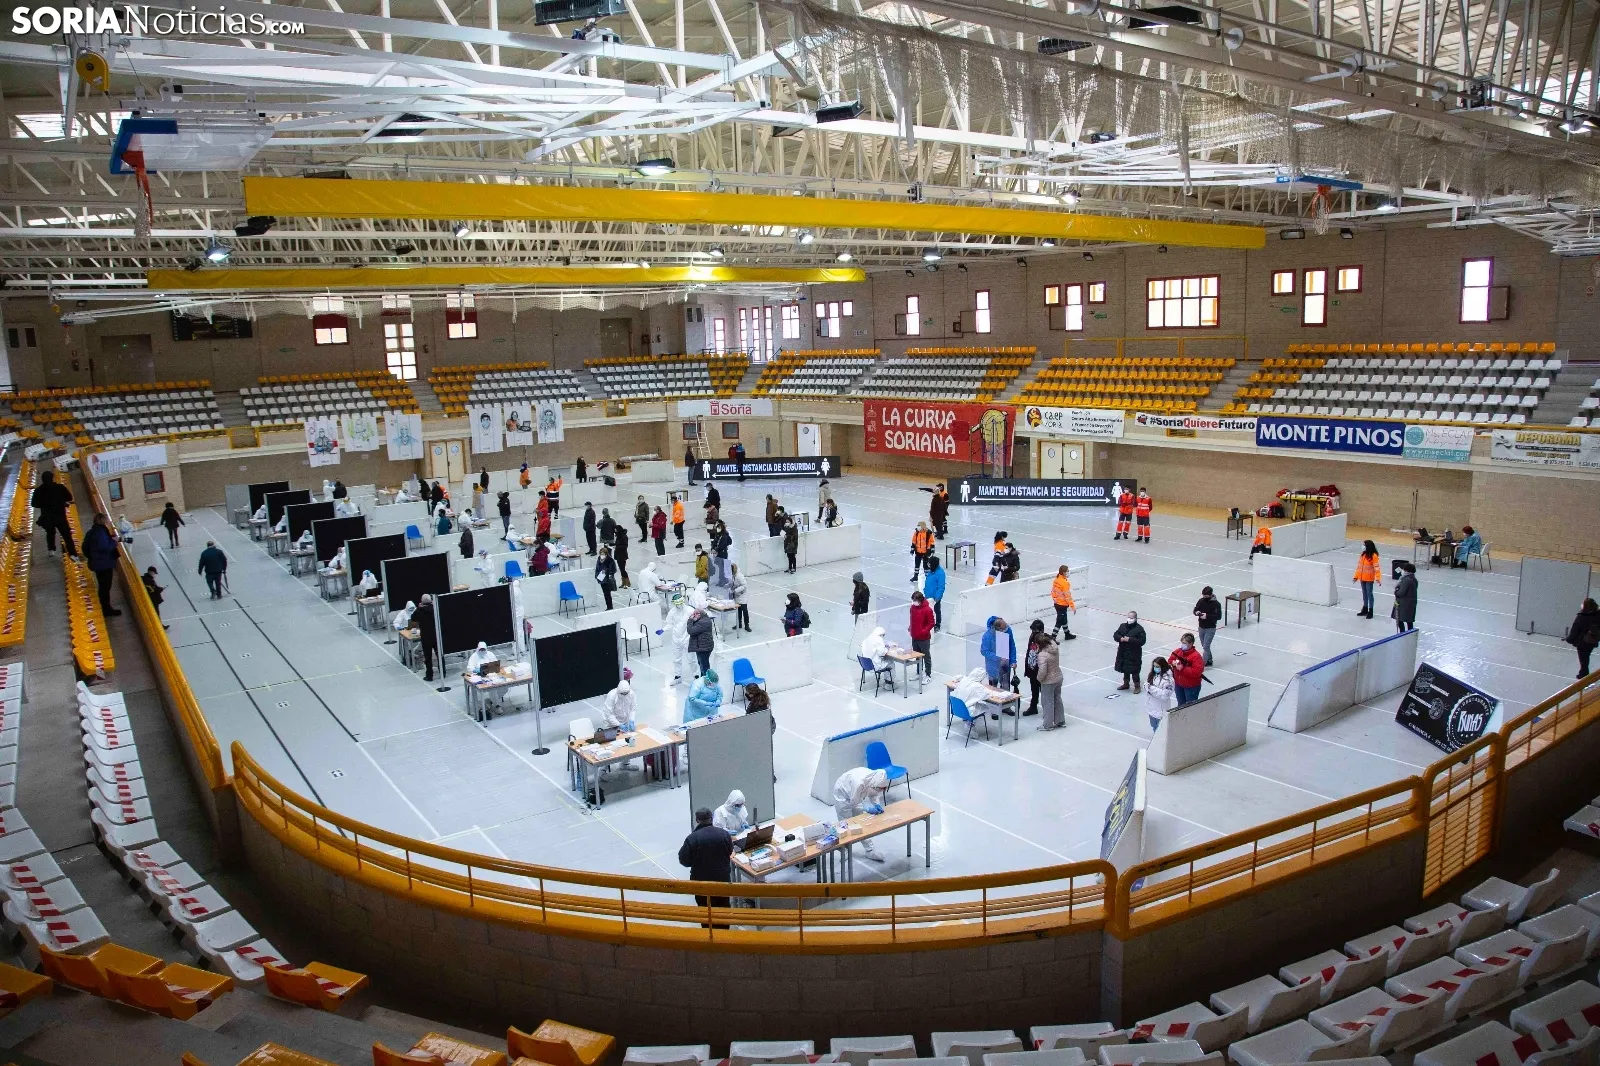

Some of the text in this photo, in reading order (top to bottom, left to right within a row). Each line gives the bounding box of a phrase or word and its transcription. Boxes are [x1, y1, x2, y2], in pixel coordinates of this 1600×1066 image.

[721, 403, 752, 415] Soria
[882, 407, 956, 430] LA CURVA
[1149, 416, 1256, 430] #SoriaQuiereFuturo
[884, 429, 956, 454] SORIANA
[1260, 423, 1331, 442] MONTE
[1334, 426, 1403, 448] PINOS
[1515, 432, 1581, 446] DEPORAMA
[717, 462, 816, 473] MANTE DISTANCIA DE SEGURIDAD
[978, 486, 1105, 497] MANTEN DISTANCIA DE SEGURIDAD
[963, 550, 968, 559] 2
[1247, 602, 1252, 613] 1
